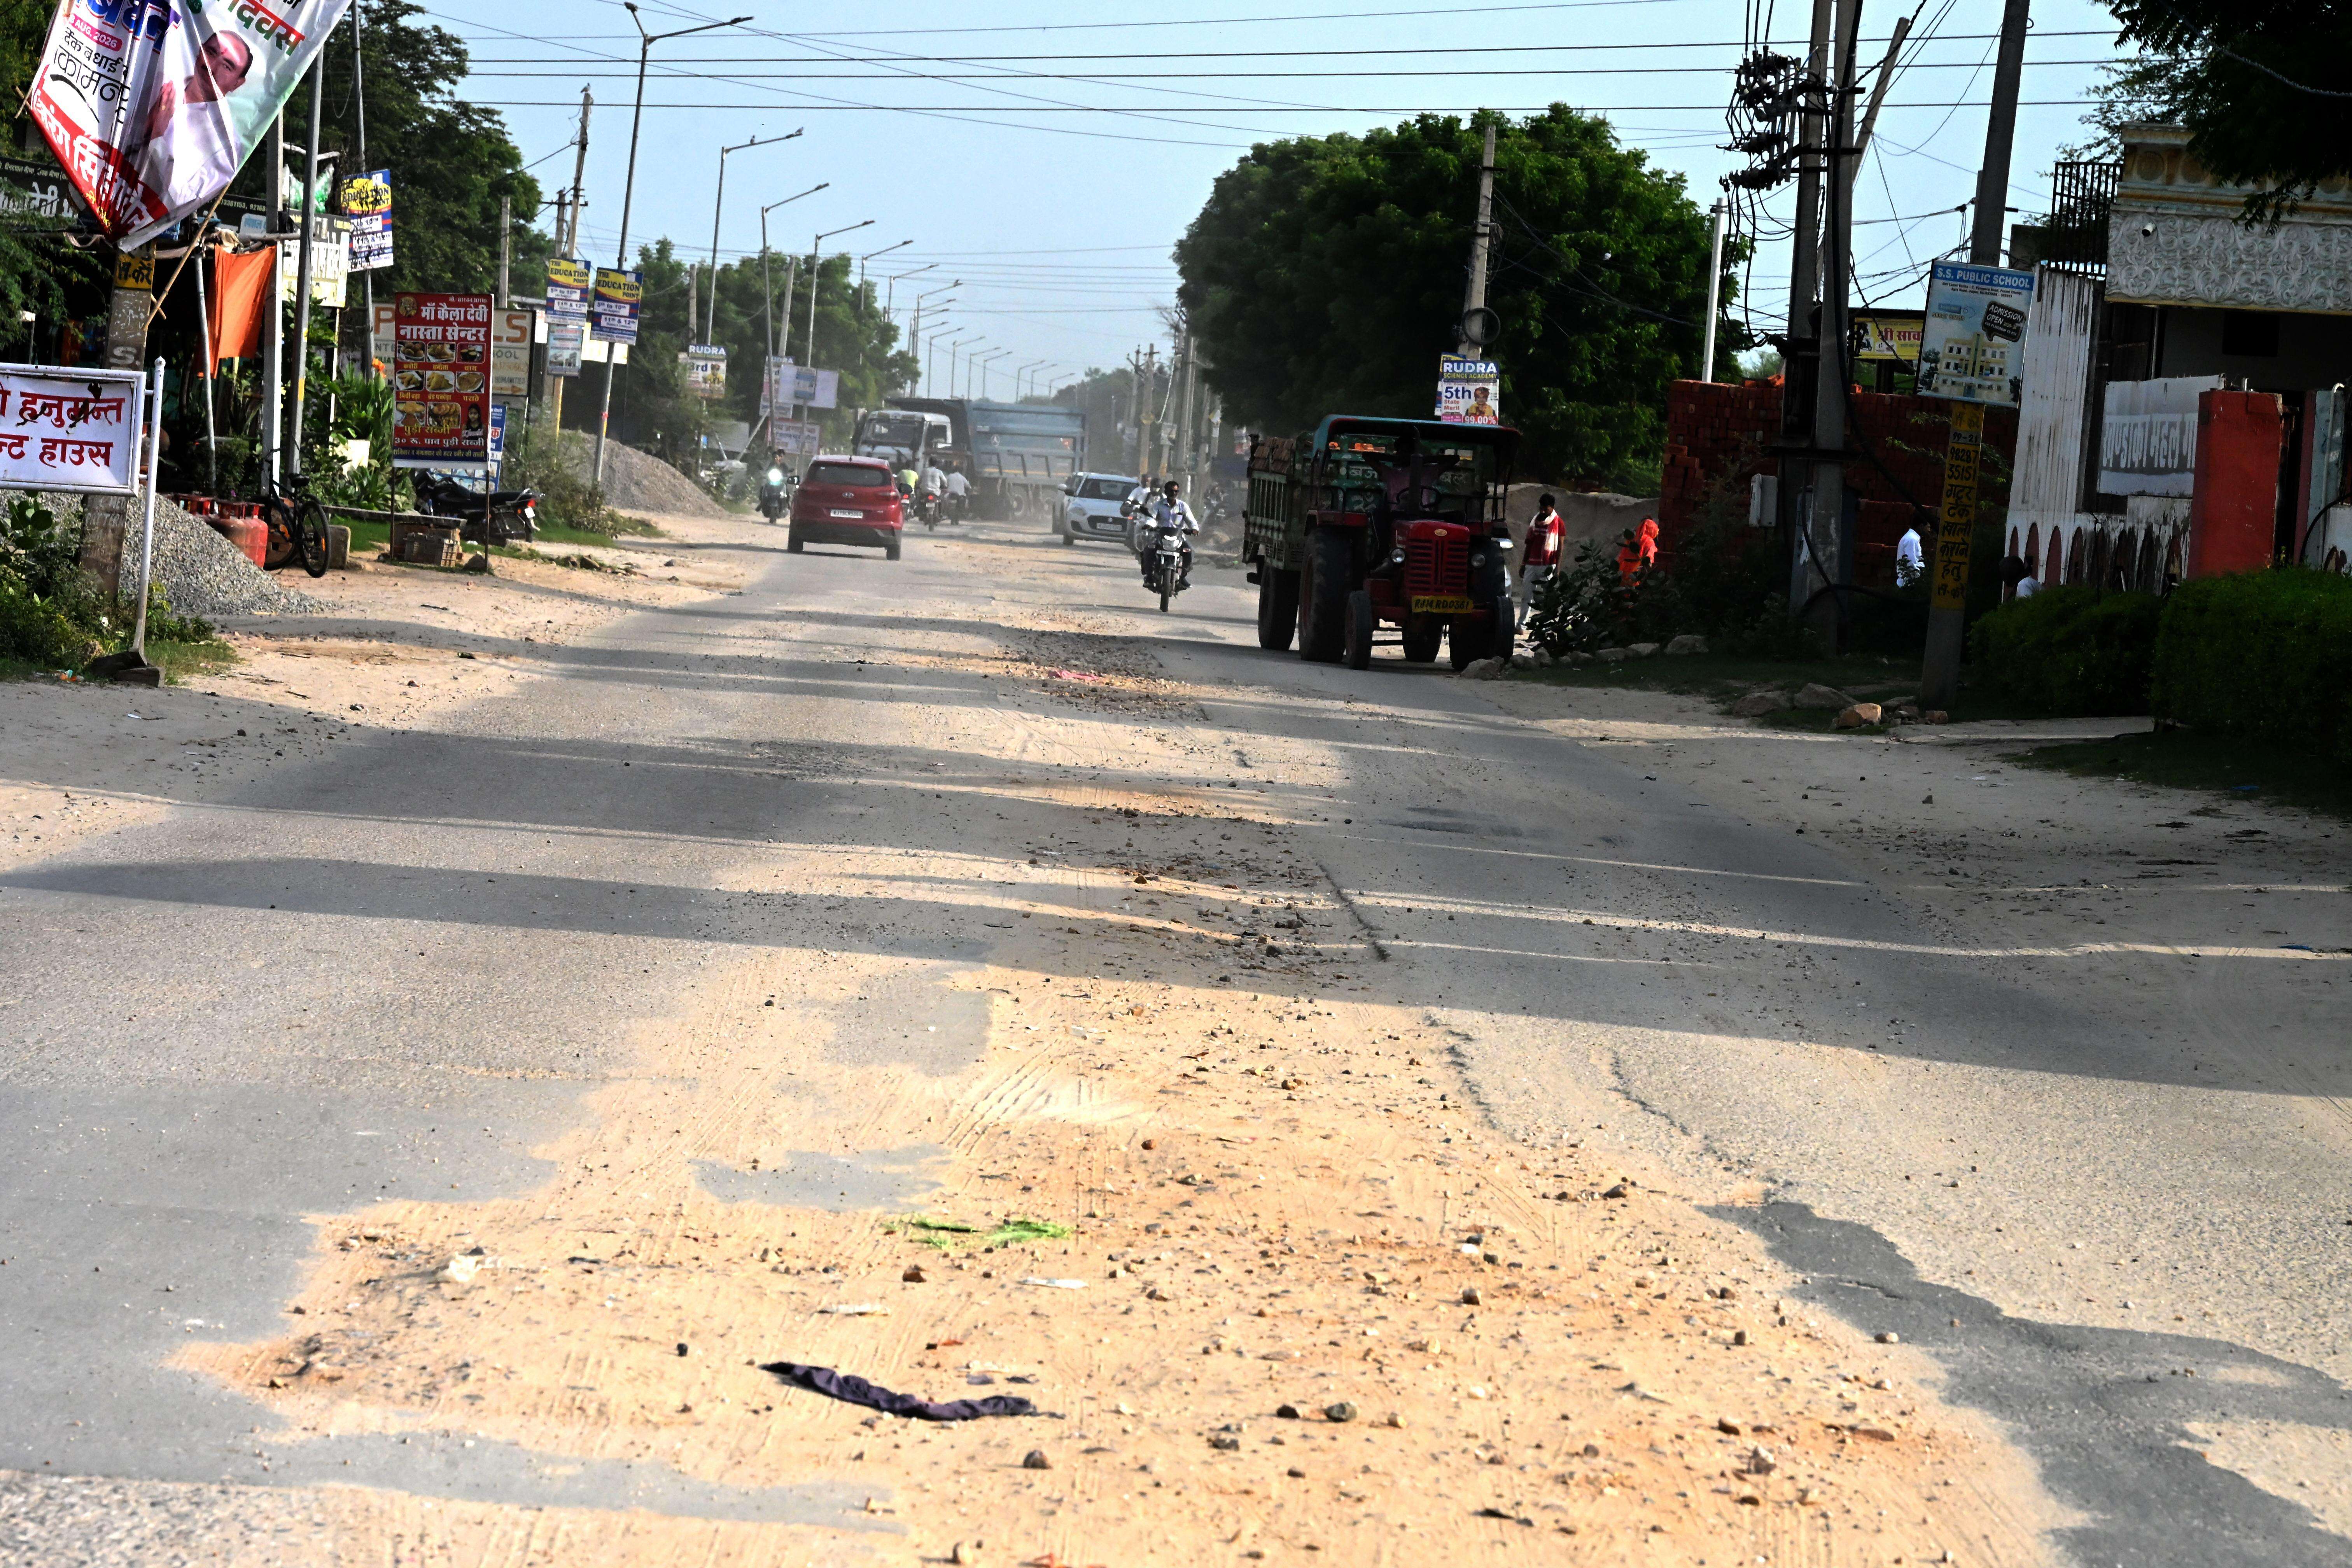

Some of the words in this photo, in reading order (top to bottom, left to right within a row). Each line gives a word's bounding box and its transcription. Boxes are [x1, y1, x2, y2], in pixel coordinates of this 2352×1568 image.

[75, 20, 92, 37] AUG.
[94, 31, 117, 48] 2026
[550, 268, 589, 277] EDUCATION
[1937, 268, 1954, 279] S.S.
[1957, 270, 1991, 283] PUBLIC
[1993, 275, 2030, 288] SCHOOL
[597, 279, 640, 292] EDUCATION
[437, 302, 466, 321] कैला
[466, 304, 489, 322] देवी
[1986, 313, 2004, 325] OPEN
[1989, 304, 2023, 322] ADMISSION
[399, 325, 444, 340] नास्ता
[445, 322, 487, 341] सेन्टर
[689, 345, 726, 355] RUDRA
[1443, 362, 1497, 373] RUDRA
[1444, 384, 1472, 399] 5th
[1465, 415, 1496, 425] 99.00%
[2150, 413, 2181, 469] महल
[2182, 413, 2199, 469] गा
[39, 438, 114, 468] हाउस
[1950, 446, 1979, 464] 98287
